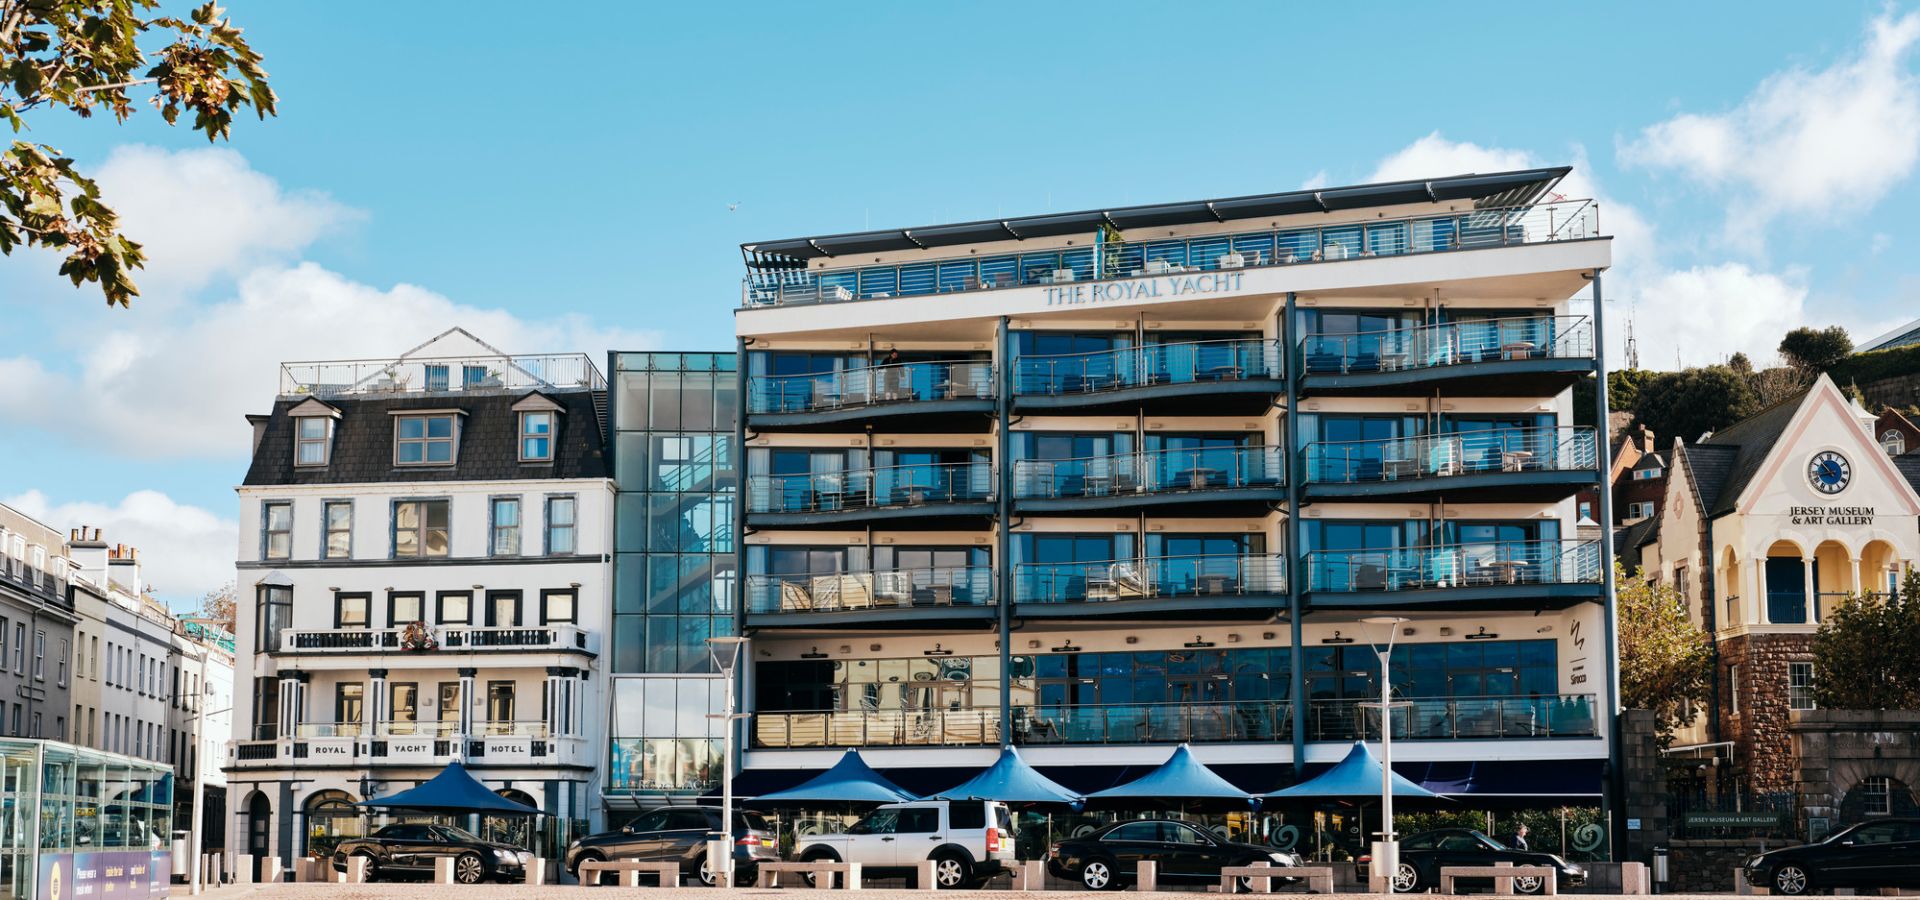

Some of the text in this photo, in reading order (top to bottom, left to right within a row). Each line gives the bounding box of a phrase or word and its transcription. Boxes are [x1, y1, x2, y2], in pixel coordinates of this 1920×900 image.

[1043, 271, 1245, 305] THE ROYAL YACHT
[1789, 506, 1875, 517] JERSEY MUSEUM
[1791, 516, 1874, 525] & ART GALLERY
[315, 746, 346, 754] ROYAL
[491, 745, 525, 753] HOTEL
